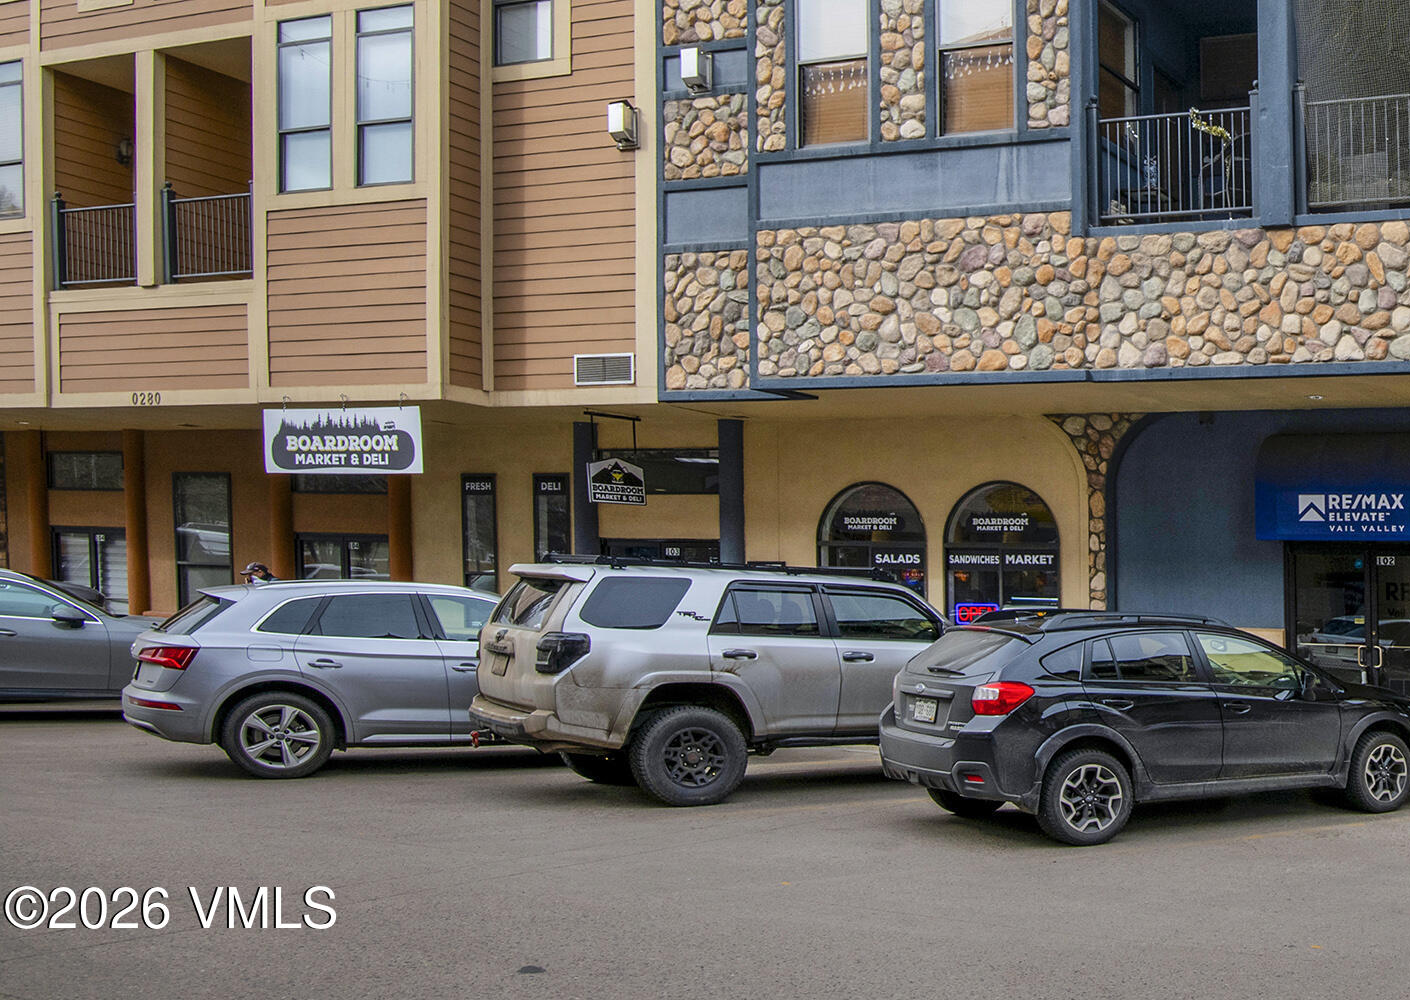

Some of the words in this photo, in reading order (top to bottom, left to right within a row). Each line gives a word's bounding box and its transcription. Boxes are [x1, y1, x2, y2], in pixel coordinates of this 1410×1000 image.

[132, 392, 161, 405] 0280
[286, 434, 400, 451] BOARDROOM
[295, 453, 347, 465] MARKET
[350, 453, 359, 464] &
[363, 453, 389, 465] DELI
[465, 481, 492, 491] FRESH
[540, 481, 561, 491] DELI
[592, 484, 644, 495] BOARDROOM
[595, 493, 621, 501] MARKET
[1328, 494, 1404, 510] RE/MAX
[844, 517, 897, 525] BOARDROOM
[972, 517, 1029, 526] BOARDROOM
[875, 553, 921, 564] SALADS
[949, 554, 1000, 565] SANDWICHES
[1005, 554, 1054, 565] MARKET
[1376, 556, 1395, 566] 102
